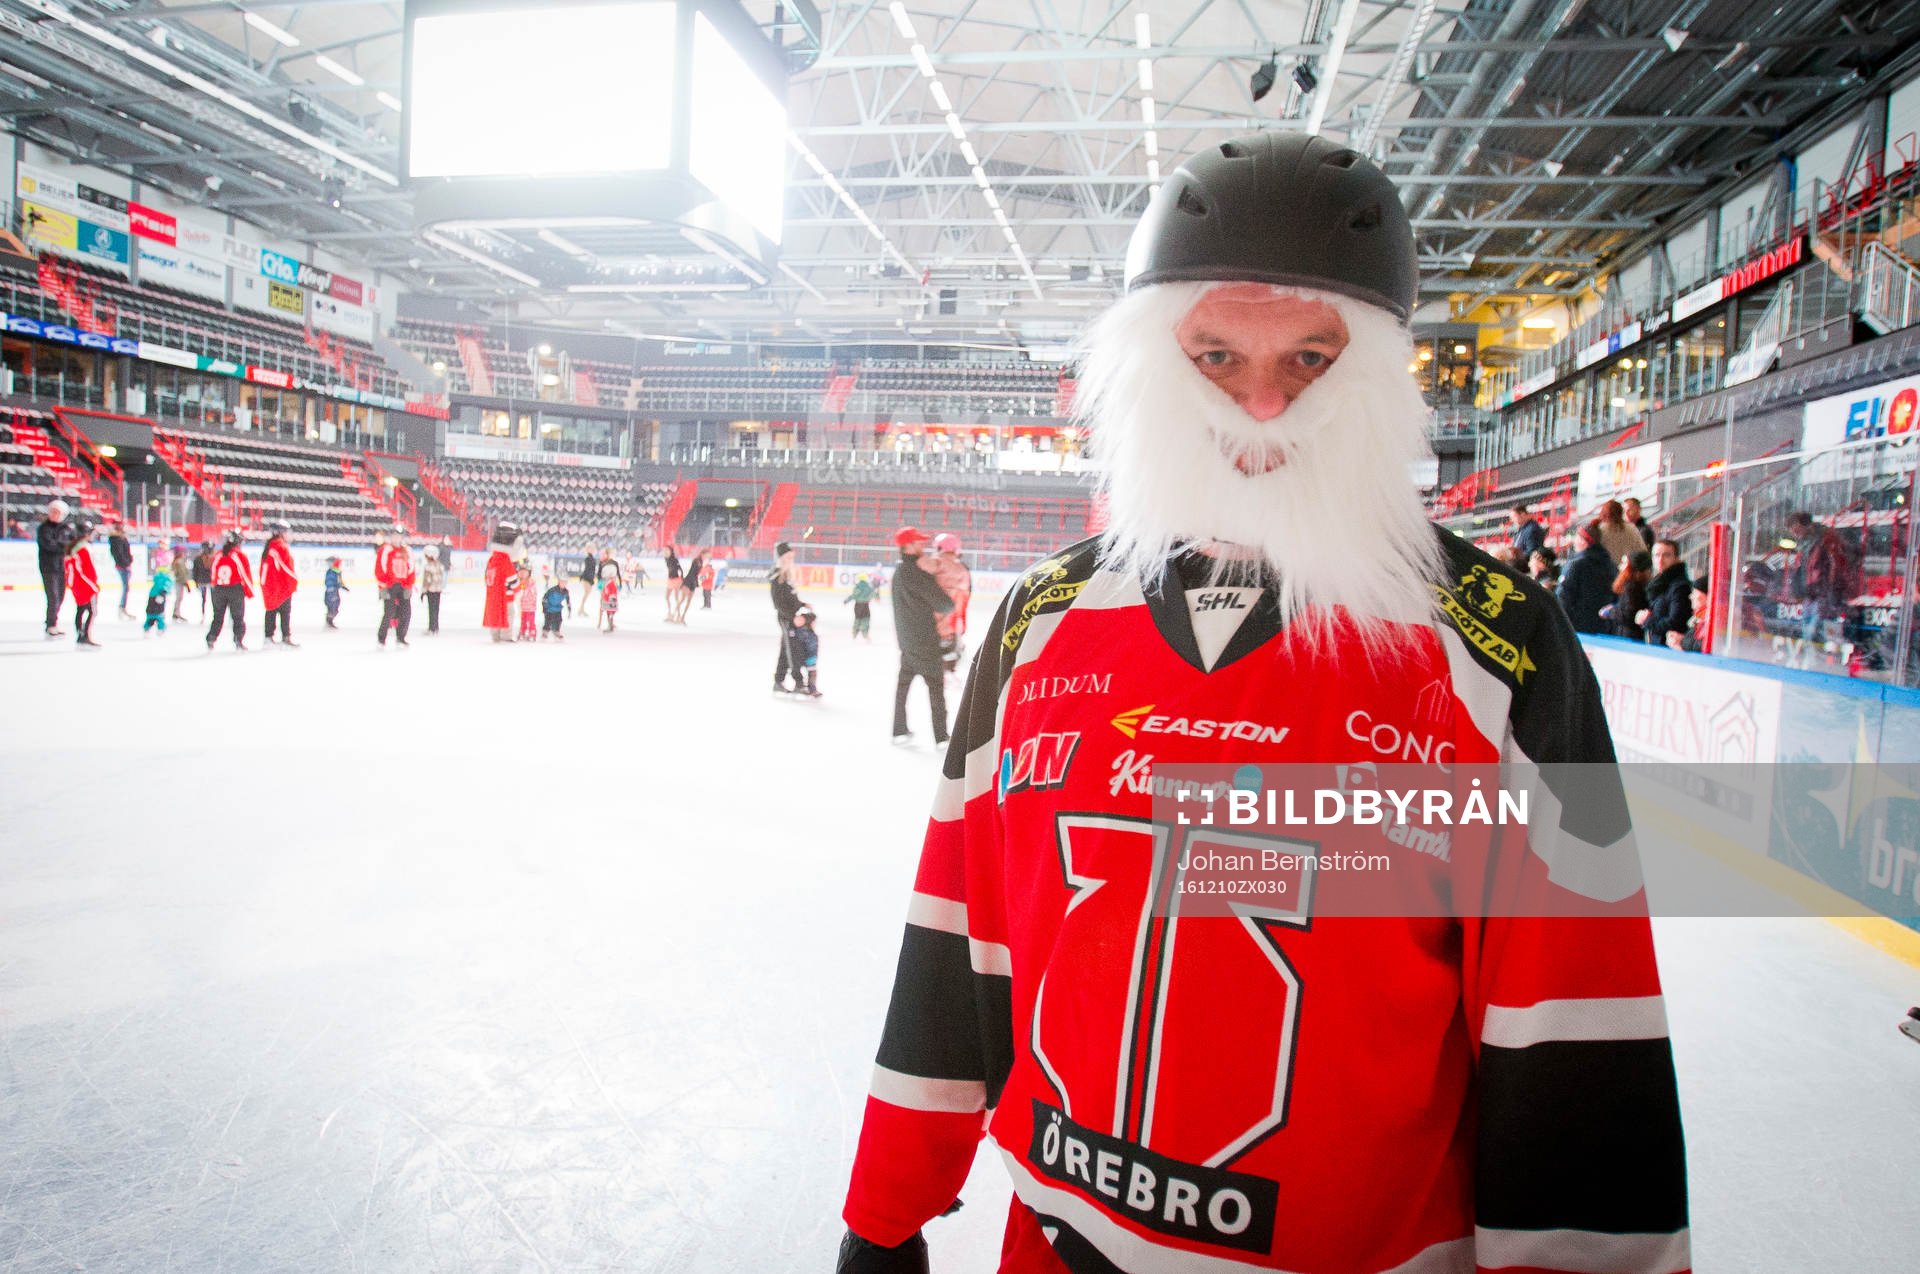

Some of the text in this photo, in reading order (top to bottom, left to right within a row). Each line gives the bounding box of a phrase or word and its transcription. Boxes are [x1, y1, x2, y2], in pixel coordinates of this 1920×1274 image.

[1845, 387, 1920, 441] ELO
[1194, 592, 1247, 613] SHL
[1451, 605, 1515, 663] KÖTT AB
[1141, 716, 1290, 744] EASTON
[1042, 1110, 1252, 1235] ÖREBRO
